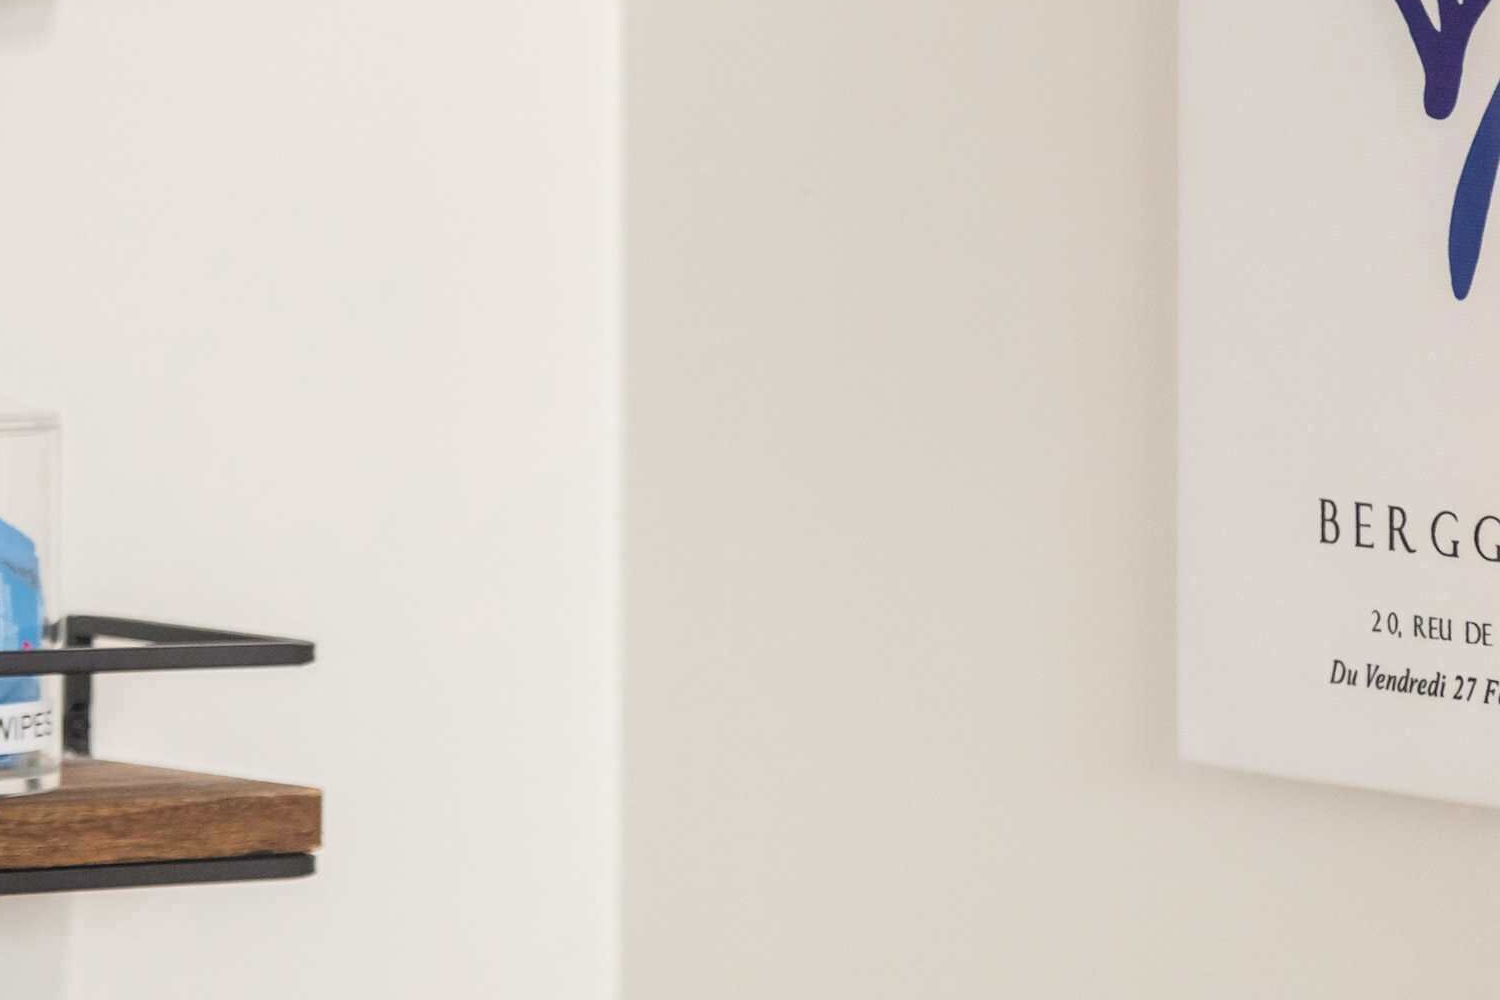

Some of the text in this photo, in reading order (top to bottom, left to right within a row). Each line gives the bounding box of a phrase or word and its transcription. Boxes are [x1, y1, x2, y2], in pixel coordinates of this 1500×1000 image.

[1318, 498, 1500, 563] BERGG
[1370, 609, 1494, 647] 20, REU DE
[1329, 658, 1500, 705] Du Vendredi 27 F
